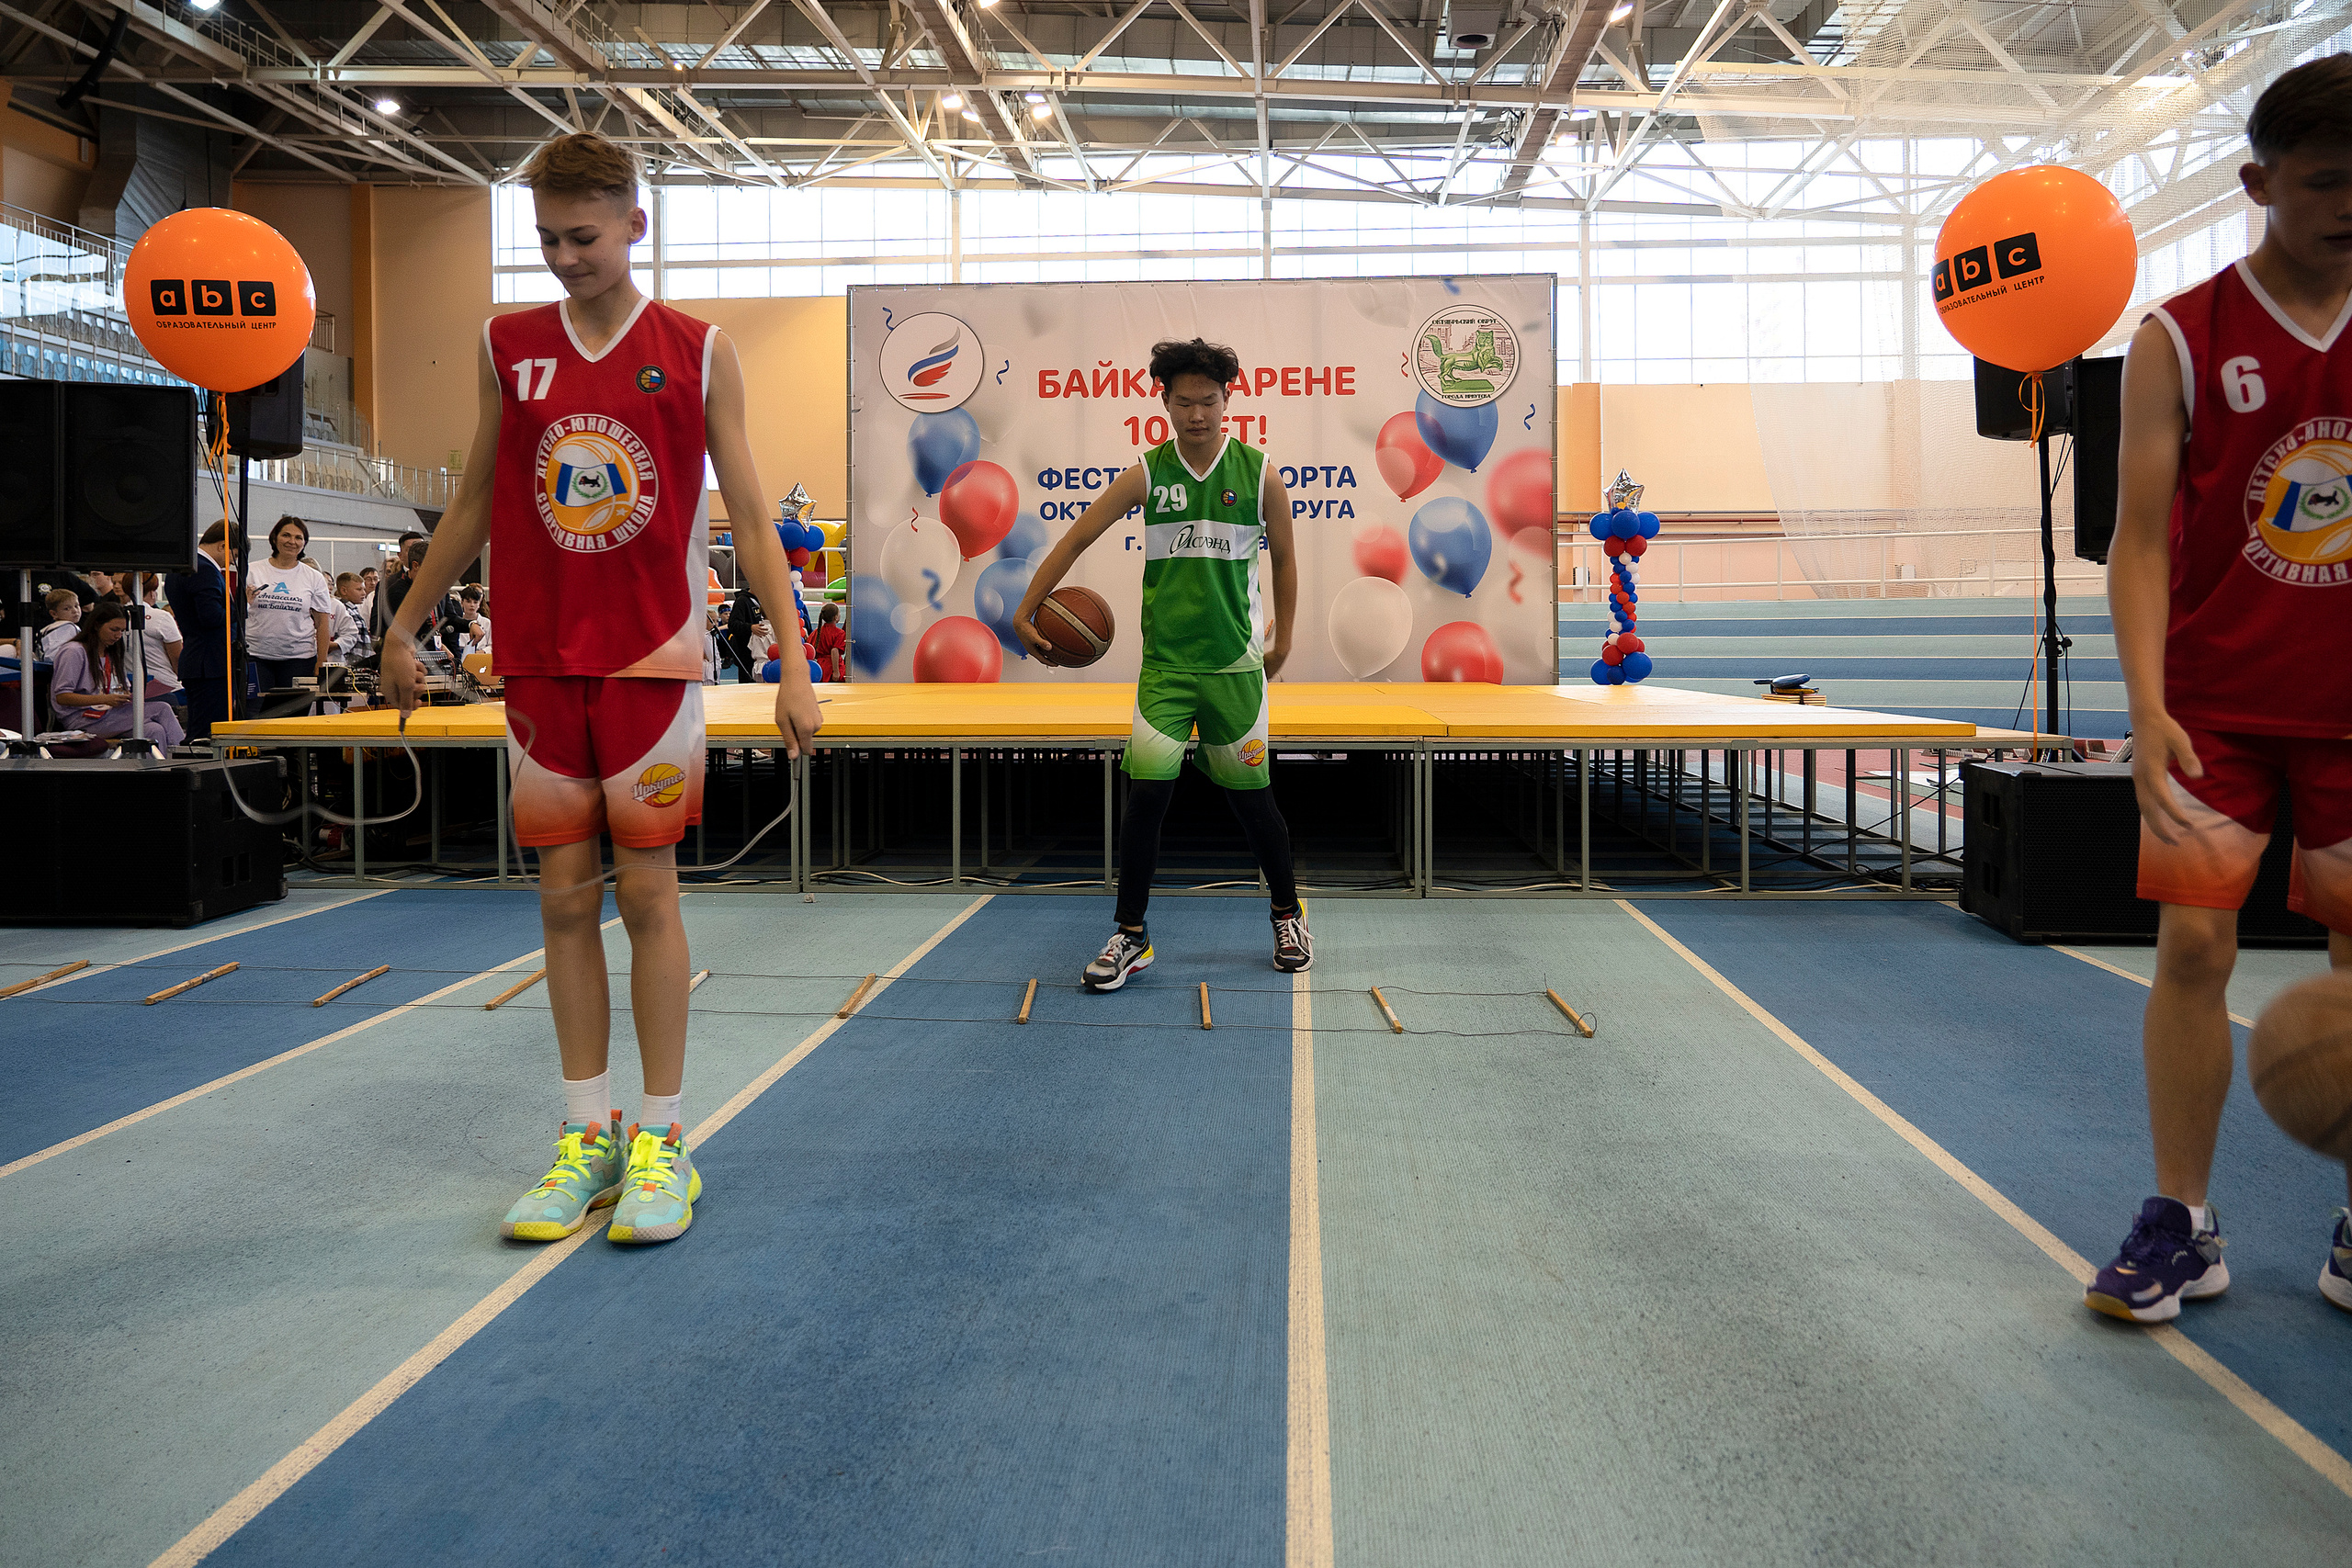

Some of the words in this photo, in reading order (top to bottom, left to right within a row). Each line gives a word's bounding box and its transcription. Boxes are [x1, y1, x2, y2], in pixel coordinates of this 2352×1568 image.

[1934, 244, 2029, 293] abc
[158, 283, 268, 310] abc
[1939, 285, 2007, 315] ОБРАЗОВАТЕЛЬНЫЙ
[2013, 276, 2045, 291] ЦЕНТР
[156, 321, 246, 330] ОБРАЗОВАТЕЛЬНЫЙ
[251, 321, 277, 330] ЦЕНТР
[511, 357, 558, 401] 17
[2220, 355, 2267, 413] 6
[1124, 415, 1170, 446] 10
[537, 416, 655, 480] ДЕТСКО-ЮНОШЕСКАЯ
[1278, 466, 1357, 489] ОРТА
[1153, 483, 1188, 513] 29
[1292, 500, 1355, 519] РУГА
[537, 491, 608, 550] СПОРТИВНАЯ
[611, 494, 654, 543] ШКОЛА
[1125, 536, 1143, 551] г.
